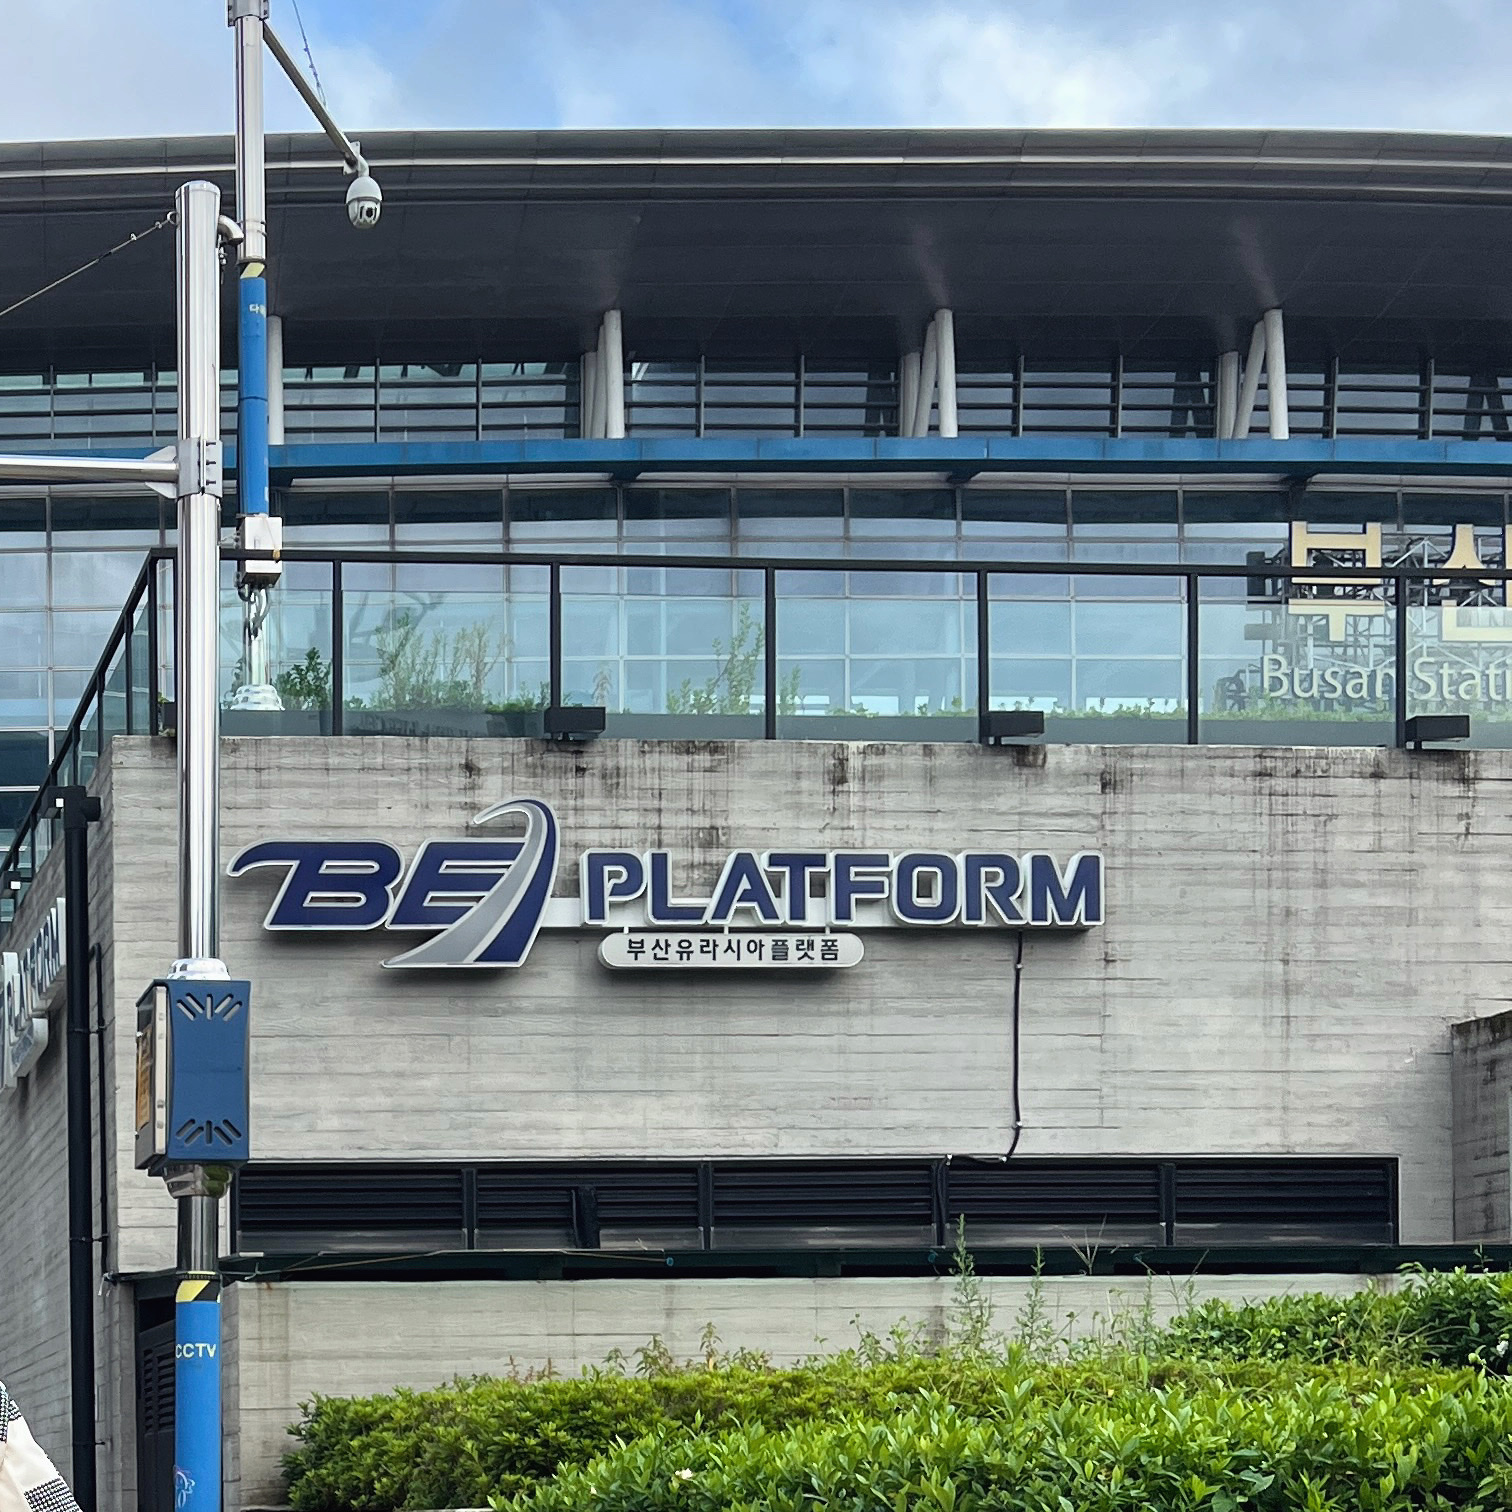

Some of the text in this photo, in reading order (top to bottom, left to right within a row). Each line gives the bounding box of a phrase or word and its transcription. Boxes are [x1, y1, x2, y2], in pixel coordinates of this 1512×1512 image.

[581, 847, 1106, 928] PLATFORM
[626, 938, 840, 961] 부산유라시아플랫폼
[175, 1342, 217, 1358] CCTV
